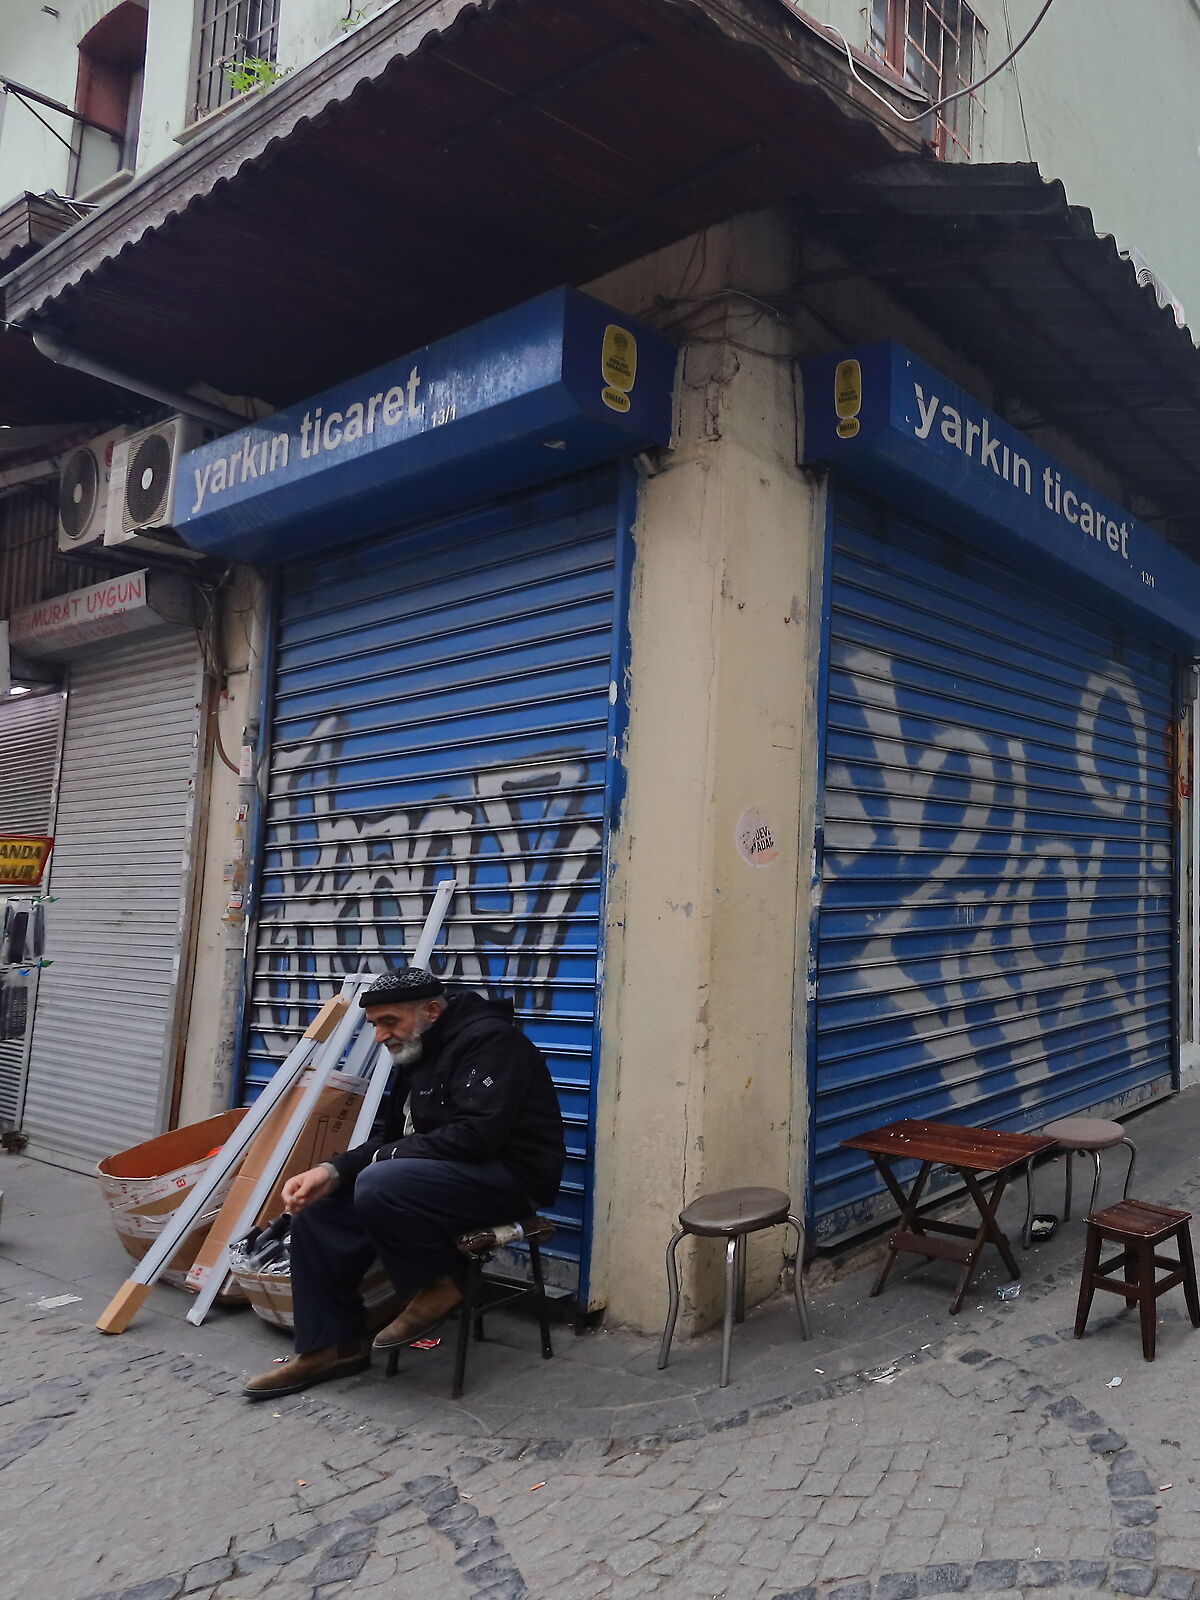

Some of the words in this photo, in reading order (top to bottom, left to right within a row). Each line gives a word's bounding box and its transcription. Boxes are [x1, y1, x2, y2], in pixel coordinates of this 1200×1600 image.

[192, 432, 290, 514] yarkın
[300, 365, 421, 460] ticaret
[431, 402, 456, 428] 13/1
[914, 382, 1032, 496] yarkın
[1042, 466, 1130, 560] ticaret
[31, 598, 81, 629] MURAT
[87, 578, 142, 614] UYGUN
[1141, 570, 1156, 588] 13/1
